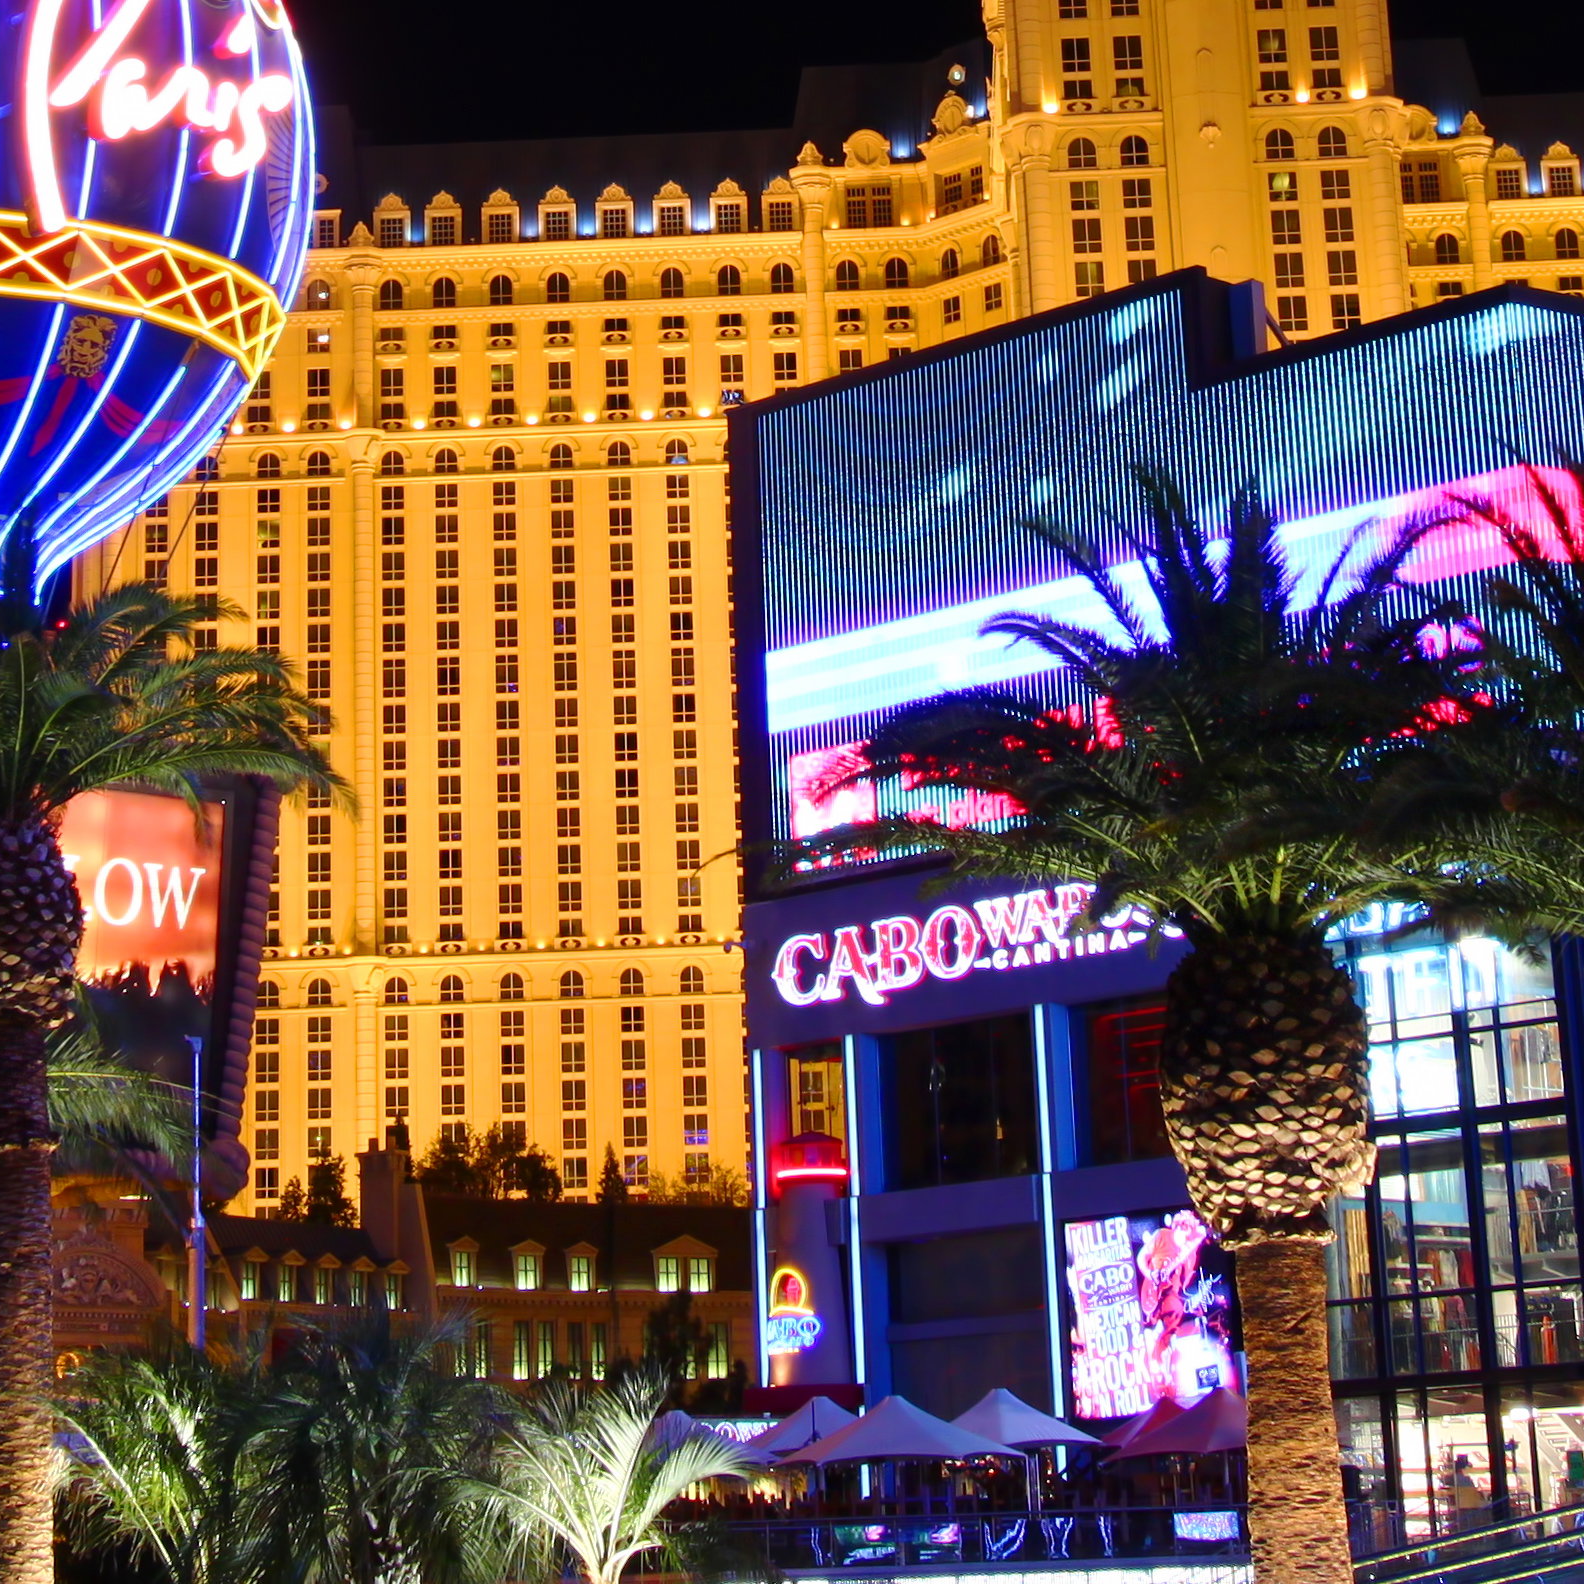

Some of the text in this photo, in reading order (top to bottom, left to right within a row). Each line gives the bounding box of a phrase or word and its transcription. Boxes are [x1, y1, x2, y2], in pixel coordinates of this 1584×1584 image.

[770, 904, 982, 1007] CABO
[992, 928, 1129, 969] CANTINA
[1071, 1217, 1129, 1253] KILLER
[1079, 1263, 1134, 1294] CABO
[1084, 1301, 1142, 1334] MEXICAN
[1088, 1323, 1144, 1359] FOOD &
[1089, 1348, 1151, 1395] ROCK
[1115, 1383, 1154, 1416] ROLL
